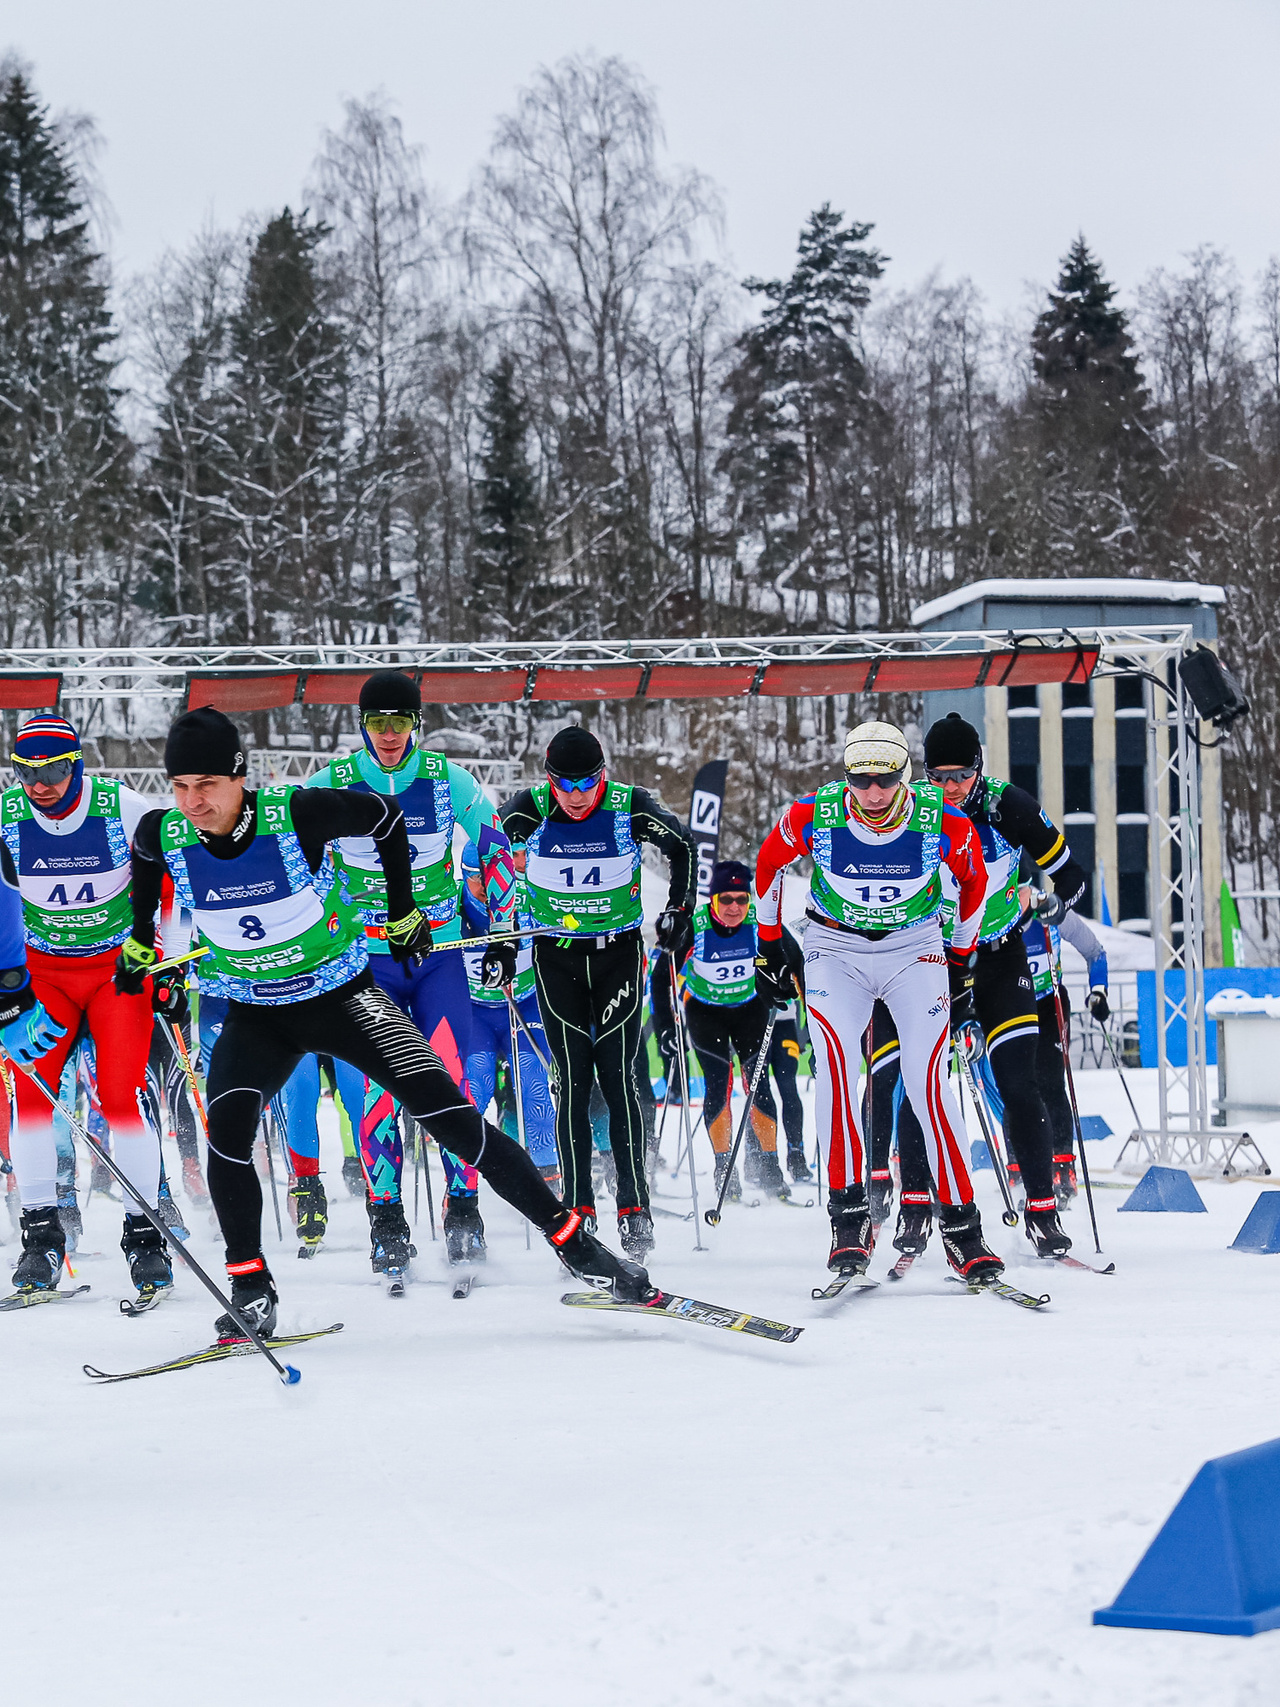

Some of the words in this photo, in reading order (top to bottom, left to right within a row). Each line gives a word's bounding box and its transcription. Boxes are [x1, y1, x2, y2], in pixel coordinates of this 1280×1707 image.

[335, 763, 353, 777] 51
[426, 757, 443, 771] 51
[341, 776, 353, 784] KM
[6, 795, 25, 813] 51
[97, 792, 116, 807] 51
[610, 791, 628, 803] 51
[265, 805, 286, 822] 51
[820, 802, 839, 818] 51
[918, 807, 939, 824] 51
[167, 819, 188, 837] 51
[825, 818, 837, 826] KM
[920, 823, 933, 831] KM
[563, 846, 607, 854] TOKSOVOCUP
[48, 860, 100, 869] TOKSOVOCUP
[560, 866, 603, 887] 14
[47, 882, 99, 905] 44
[220, 885, 277, 901] TOKSOVOCUP
[550, 904, 612, 914] TYRES
[239, 915, 267, 941] 8
[230, 953, 306, 973] TYRES
[715, 965, 746, 980] 38
